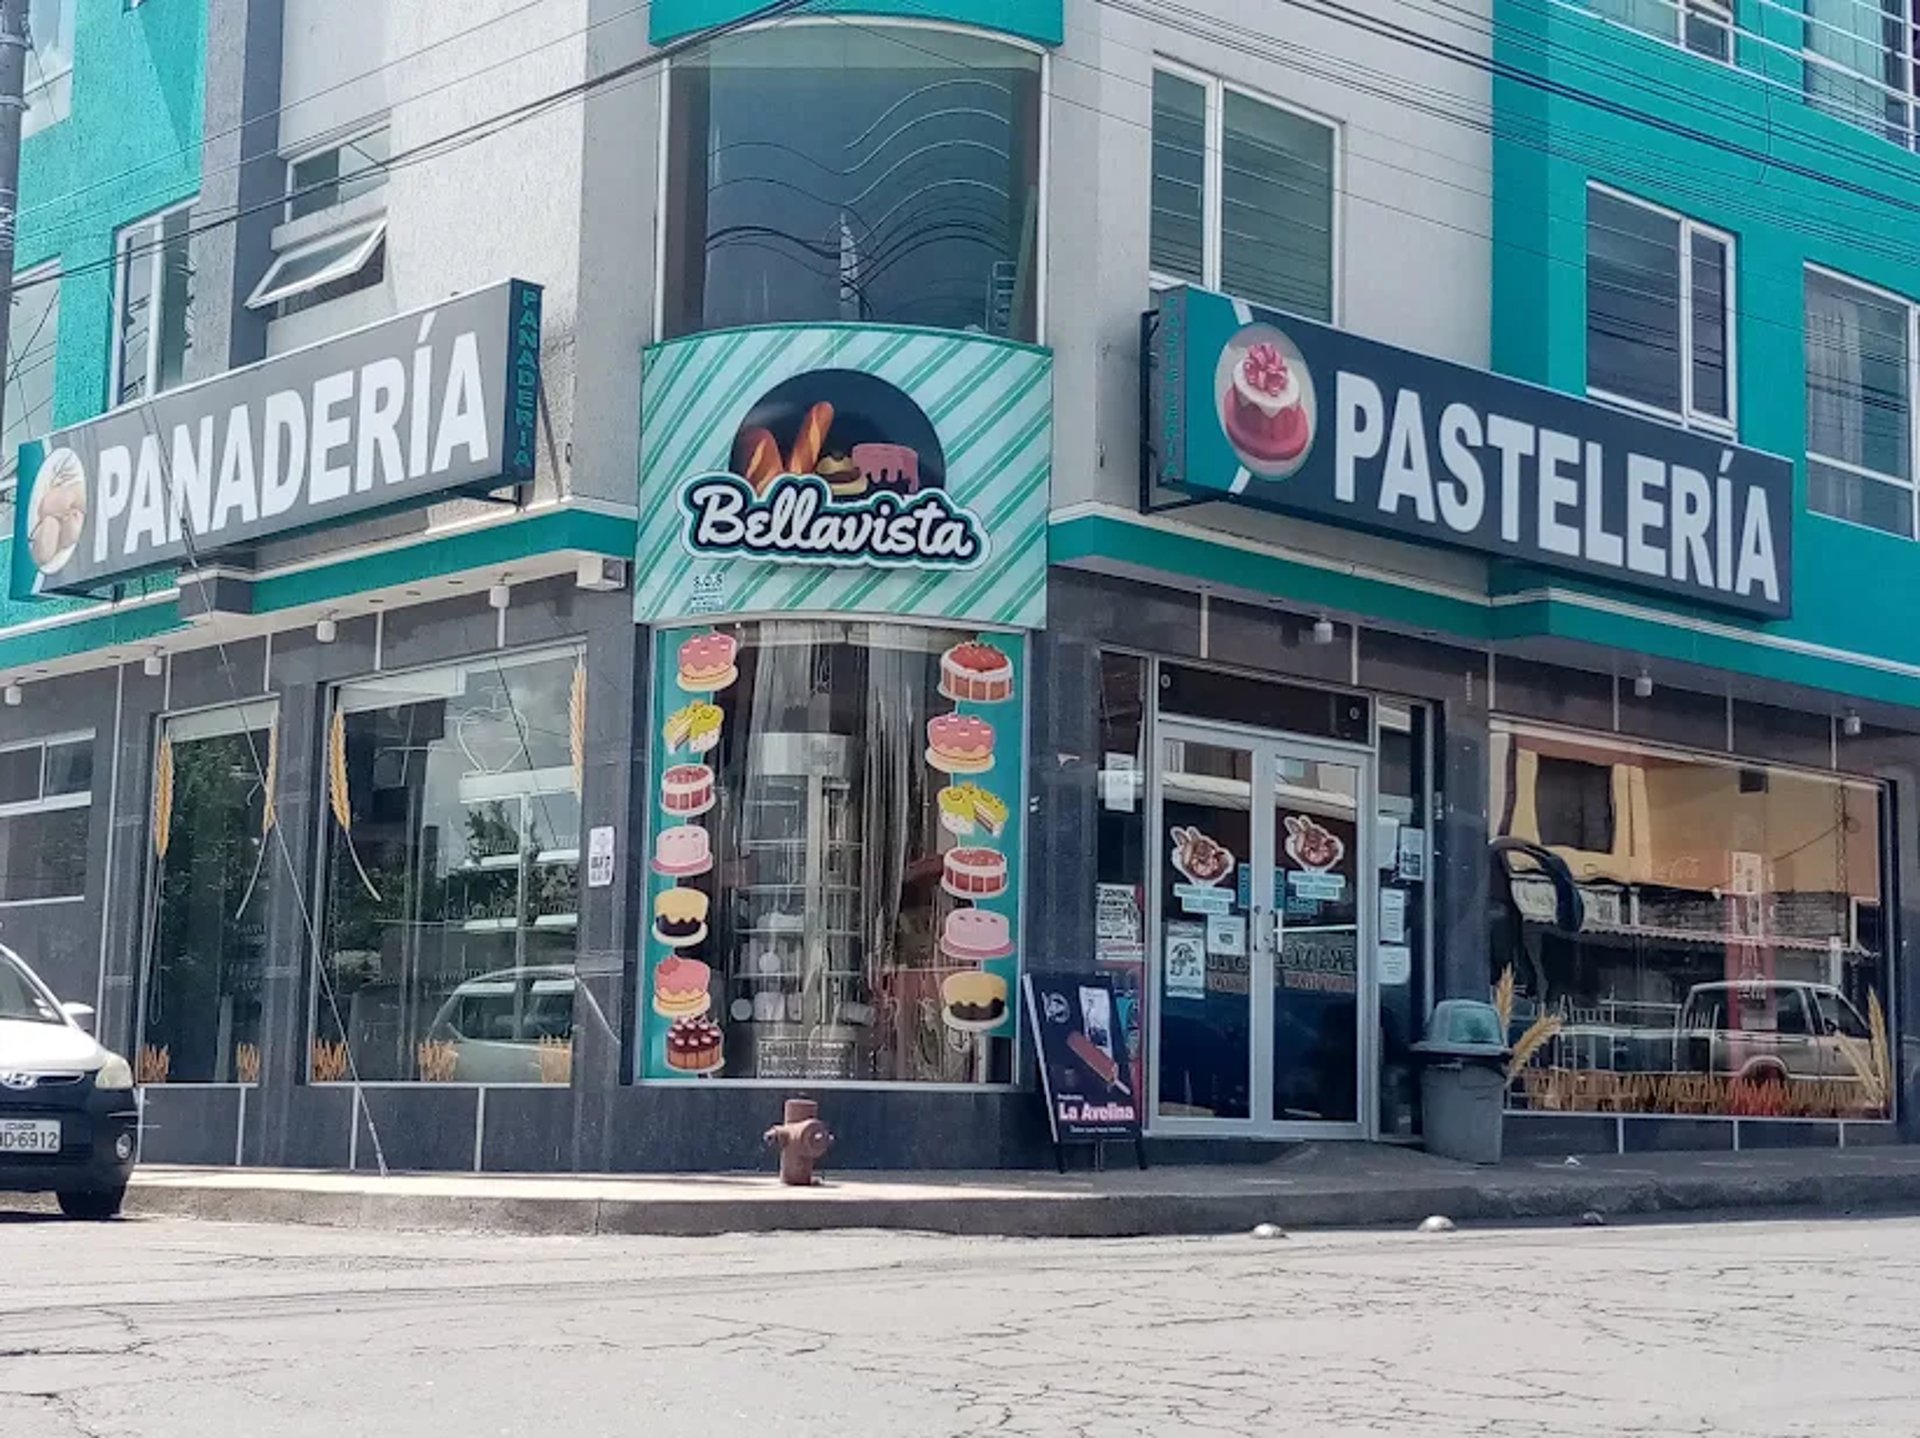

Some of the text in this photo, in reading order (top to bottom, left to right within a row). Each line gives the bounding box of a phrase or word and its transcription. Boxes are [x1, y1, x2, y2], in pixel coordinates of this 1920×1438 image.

[93, 312, 489, 562] PANADERÍA
[1335, 371, 1780, 602] PASTELERÍA
[693, 485, 973, 555] Bellavista
[1058, 1102, 1078, 1120] La
